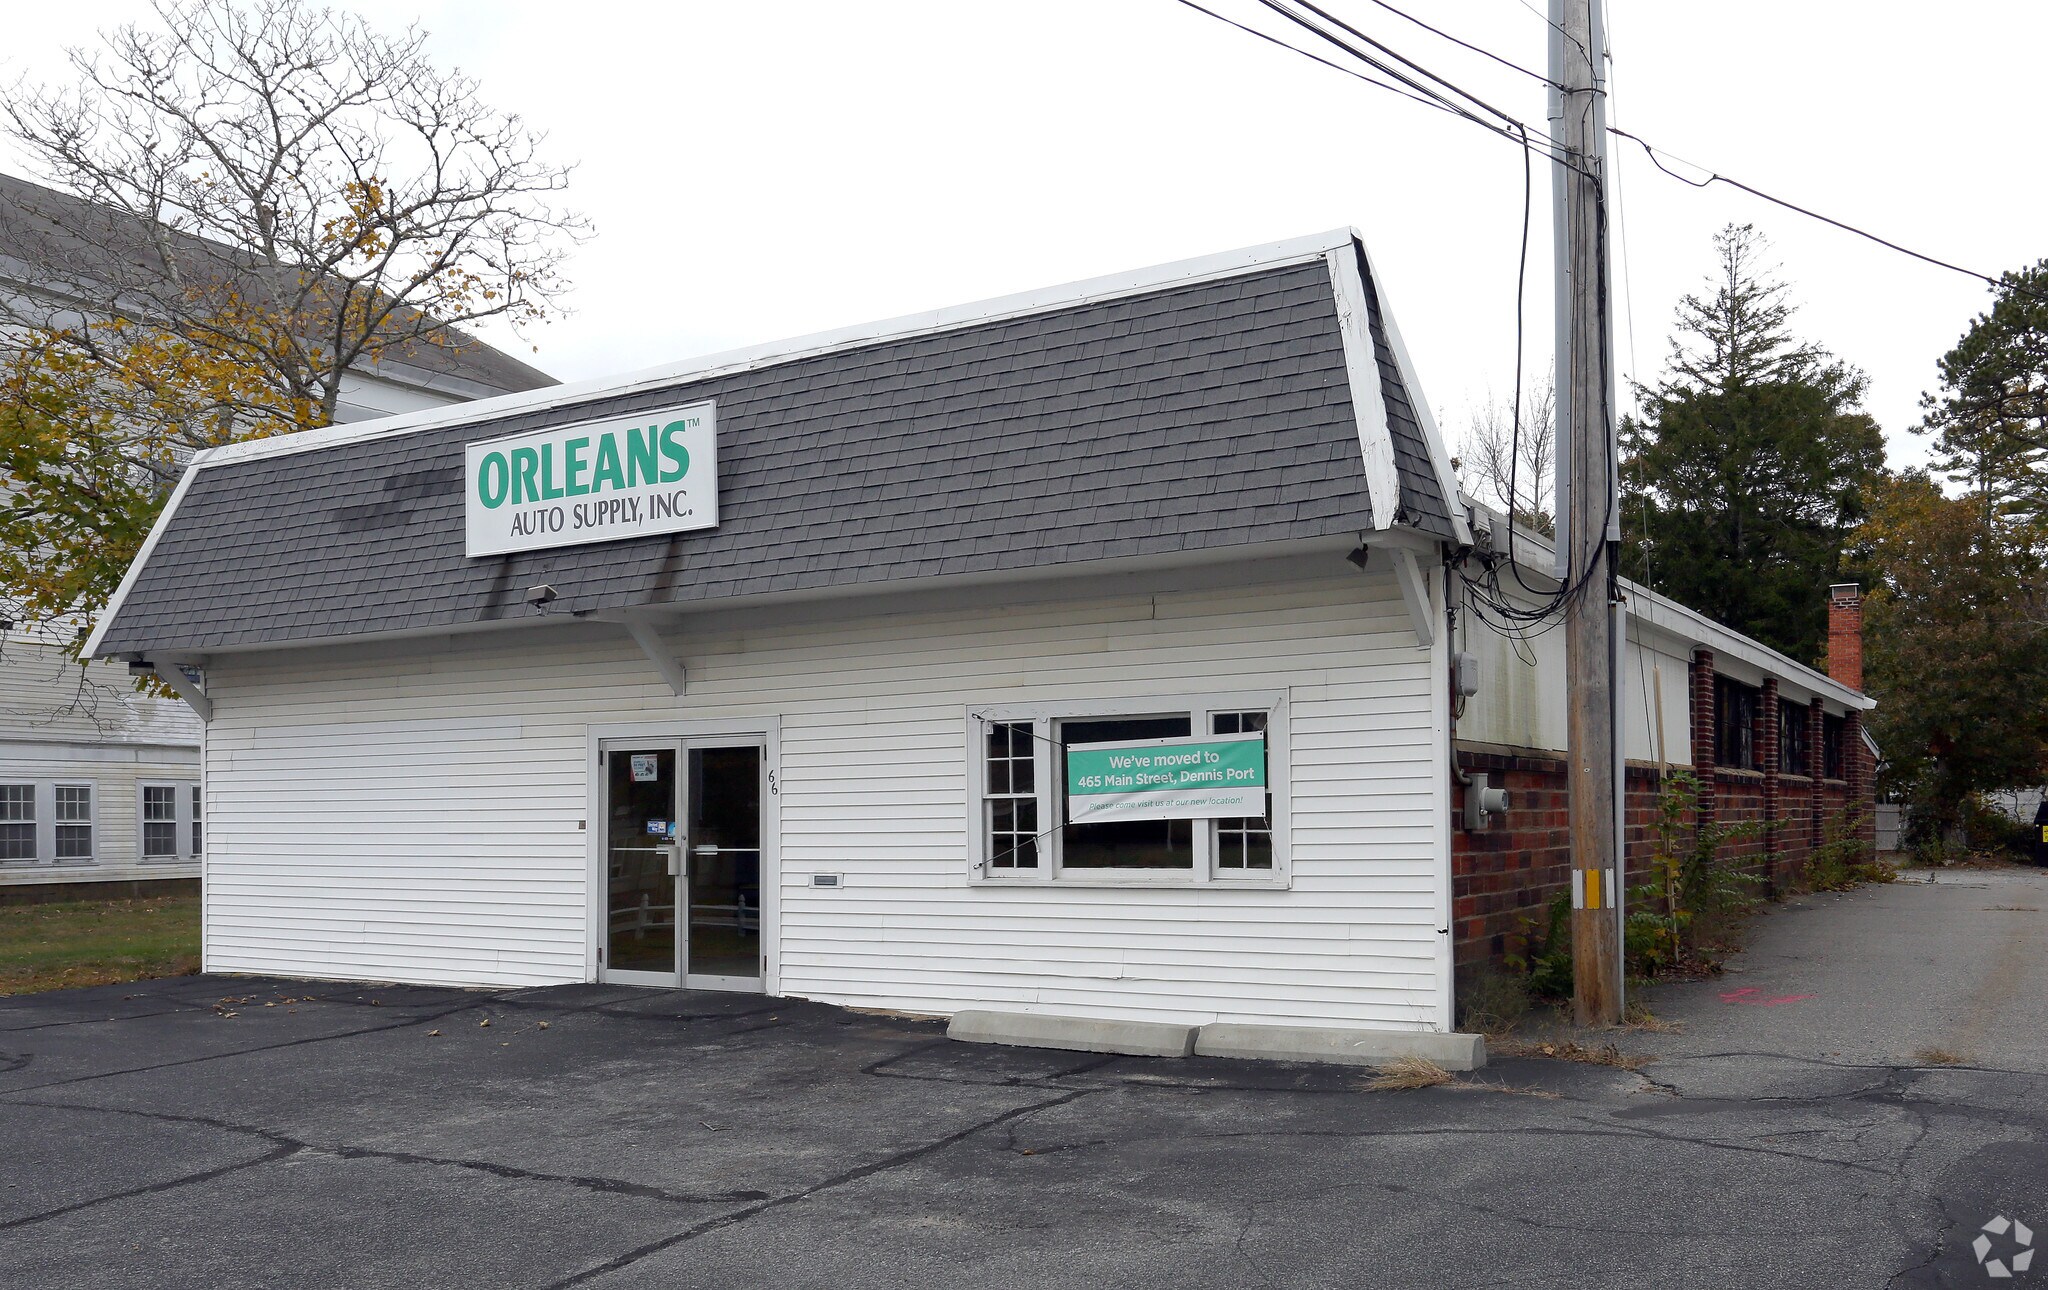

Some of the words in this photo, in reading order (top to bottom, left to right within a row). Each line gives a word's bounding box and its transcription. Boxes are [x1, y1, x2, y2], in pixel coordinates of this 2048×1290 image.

[478, 420, 690, 509] ORLEANS
[510, 506, 564, 537] AUTO
[573, 496, 643, 530] SUPPLY,
[649, 490, 693, 520] INC.
[1109, 755, 1151, 769] We've
[1153, 751, 1201, 767] moved
[1204, 751, 1219, 763] to
[1078, 775, 1101, 788] 465
[1104, 774, 1133, 787] Main
[1136, 772, 1177, 785] Street,
[1180, 769, 1223, 782] Dennis
[1226, 768, 1255, 780] Port
[1089, 801, 1114, 810] Please
[1115, 801, 1136, 809] come
[1137, 799, 1153, 808] visit
[1165, 799, 1174, 807] at
[1208, 796, 1244, 805] location!
